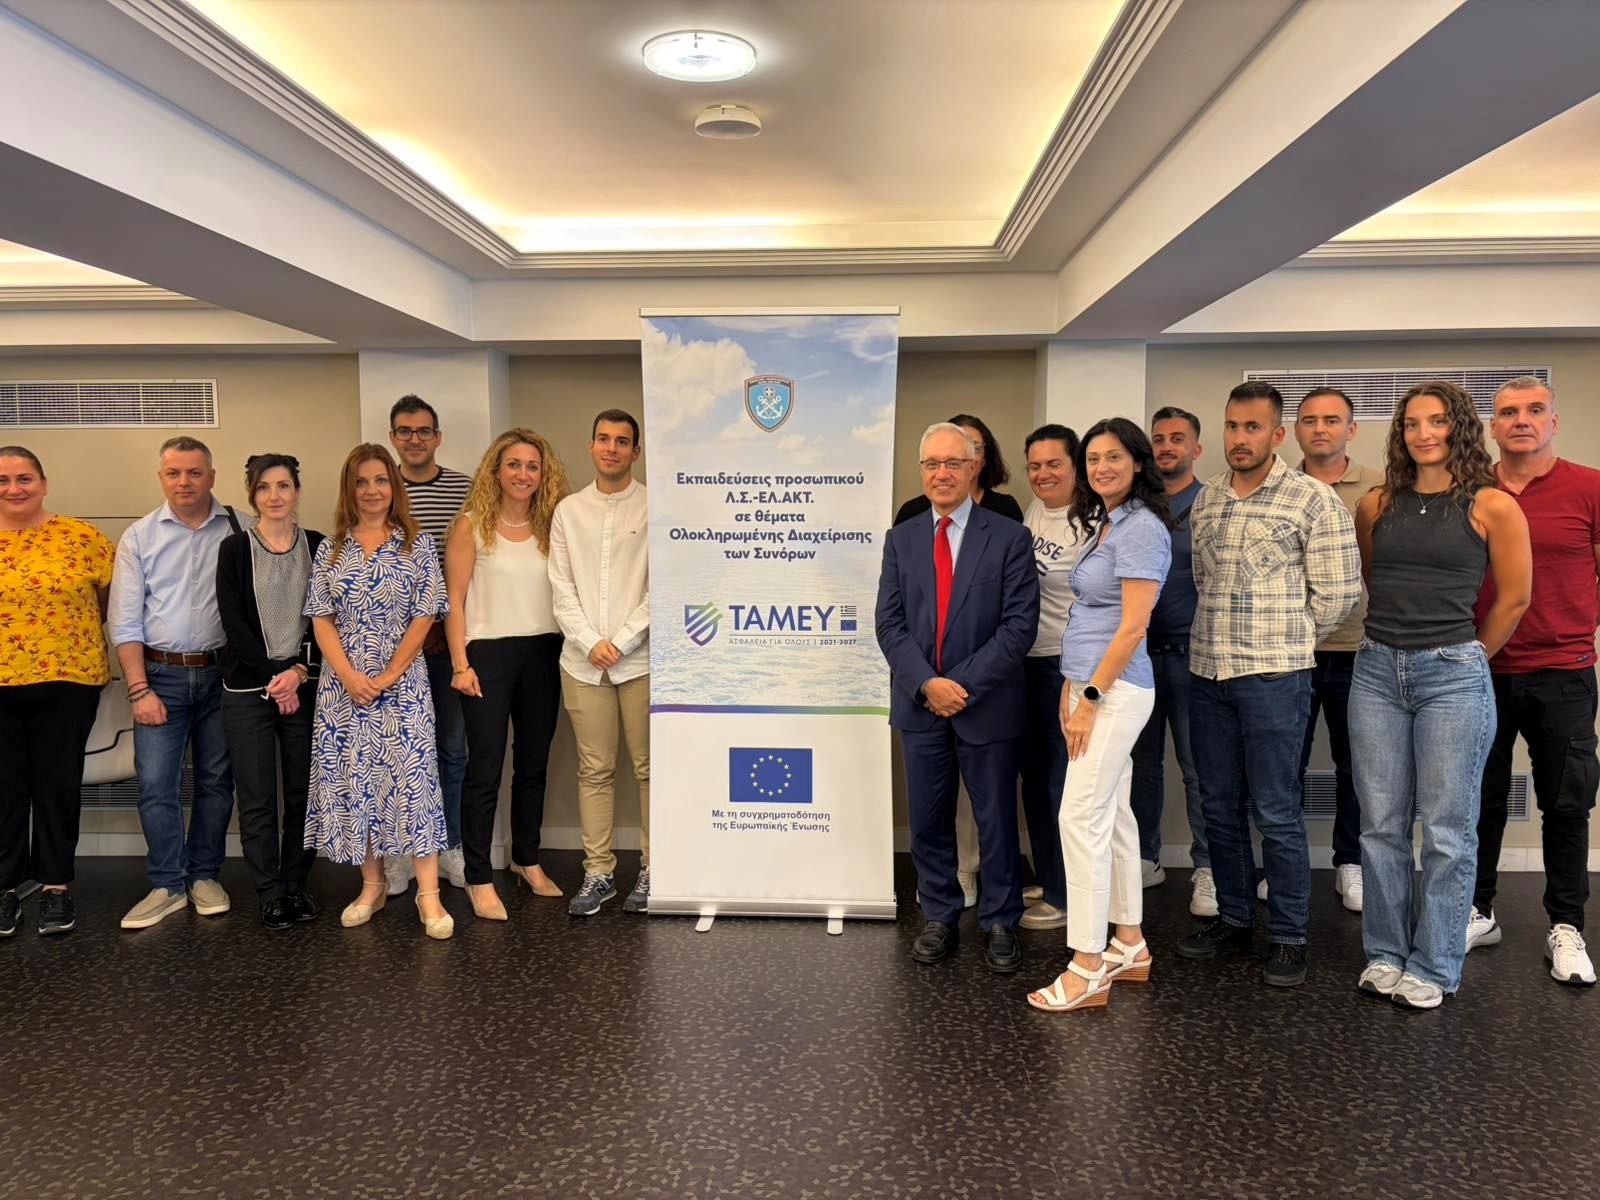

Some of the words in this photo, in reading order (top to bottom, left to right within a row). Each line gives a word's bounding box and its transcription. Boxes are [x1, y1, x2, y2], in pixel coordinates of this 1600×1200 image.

[676, 472, 771, 487] Εκπαιδεύσεις
[775, 472, 865, 487] προσωπικού
[725, 491, 815, 504] Λ.Σ.-ΕΛ.ΑΚΤ.
[735, 512, 751, 522] σε
[755, 510, 806, 525] θέματα
[669, 528, 784, 543] Ολοκληρωμένης
[788, 529, 873, 543] Διαχείρισης
[724, 550, 750, 559] των
[754, 547, 816, 562] Συνόρων
[1032, 534, 1065, 561] DISE
[728, 638, 768, 646] ΑΣΦΑΛΕΙΑ
[769, 638, 782, 646] ΓΙΑ
[784, 638, 810, 646] ΟΛΟΥΣ
[819, 638, 857, 646] 2021-2027
[711, 810, 725, 818] Με
[727, 811, 737, 819] τη
[739, 810, 831, 821] συγχρηματοδότηση
[712, 822, 728, 831] της
[730, 821, 788, 831] Ευρωπαϊκής
[789, 821, 830, 832] Ένωσης
